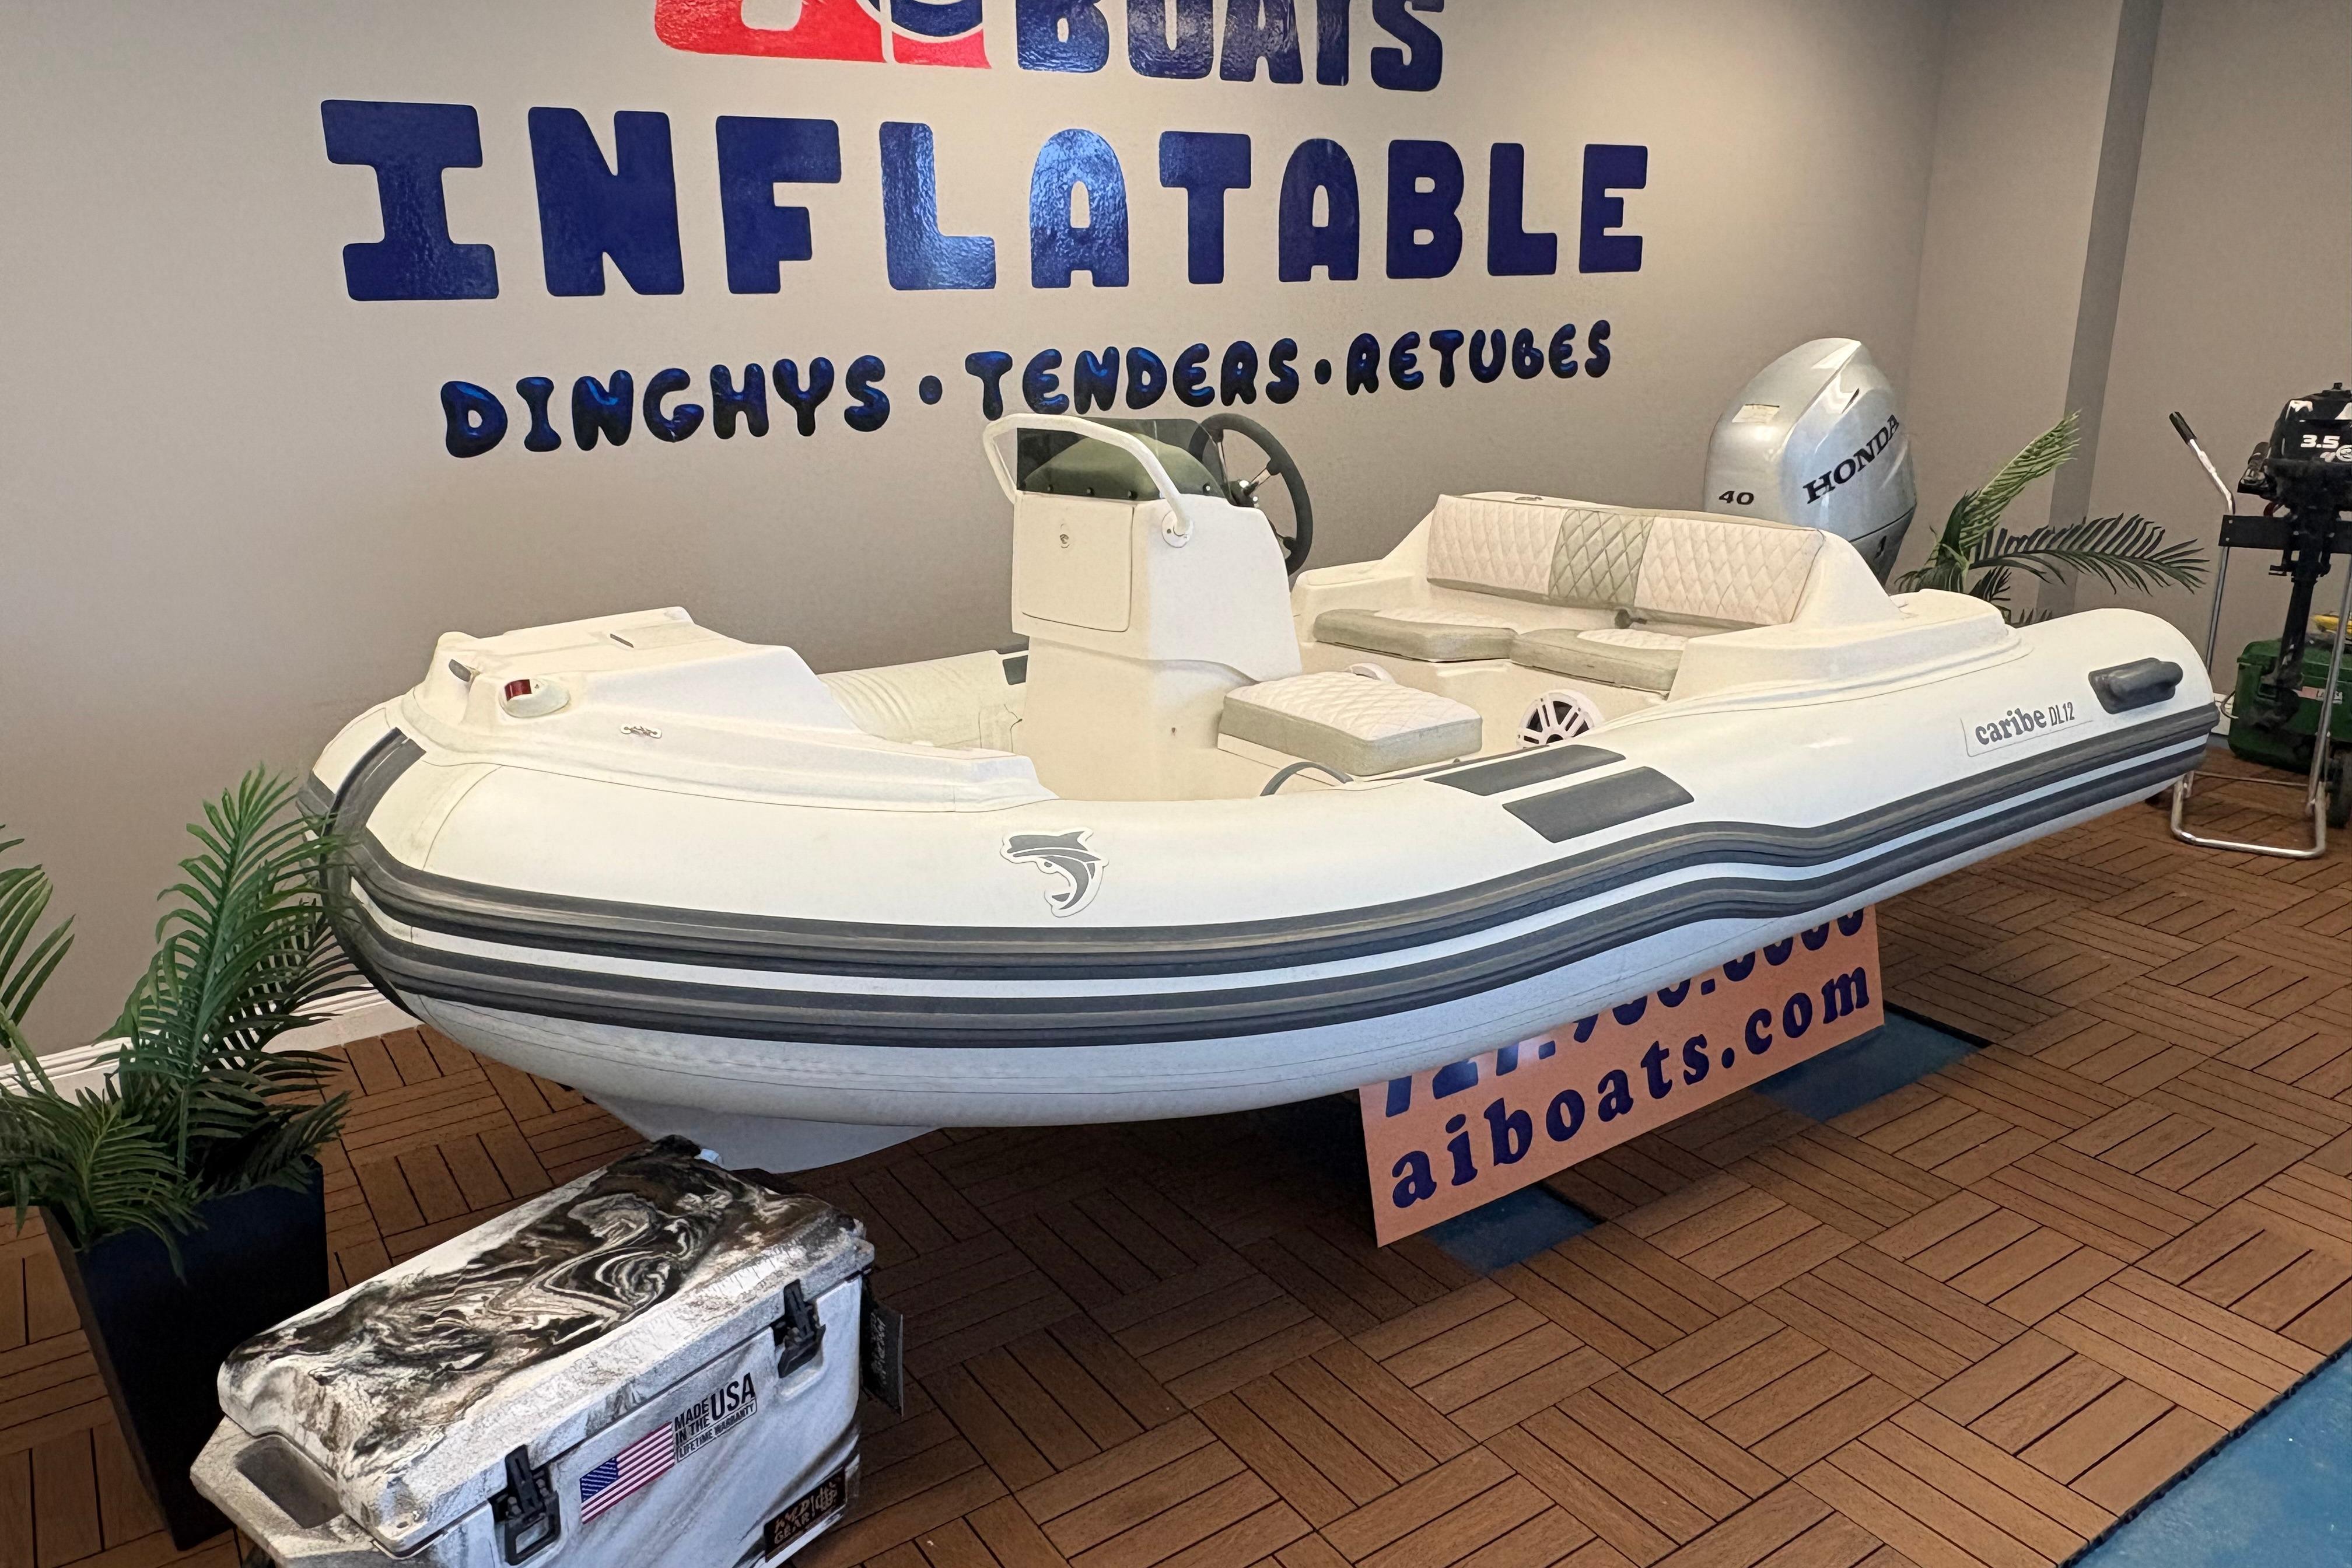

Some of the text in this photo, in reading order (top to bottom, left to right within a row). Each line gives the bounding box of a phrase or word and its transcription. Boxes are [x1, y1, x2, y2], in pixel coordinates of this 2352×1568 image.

[321, 99, 1648, 300] INFLATABLE
[440, 320, 1611, 458] DINGHYS TENDERS RETUBES
[1803, 414, 1900, 504] HONDA
[2300, 434, 2340, 449] 3.5
[1718, 490, 1755, 506] 40
[1975, 702, 2076, 746] caribe DL12
[1391, 966, 1870, 1209] aiboats.com
[674, 1398, 709, 1432] MADE
[710, 1372, 756, 1421] USA
[675, 1413, 710, 1446] IN THE
